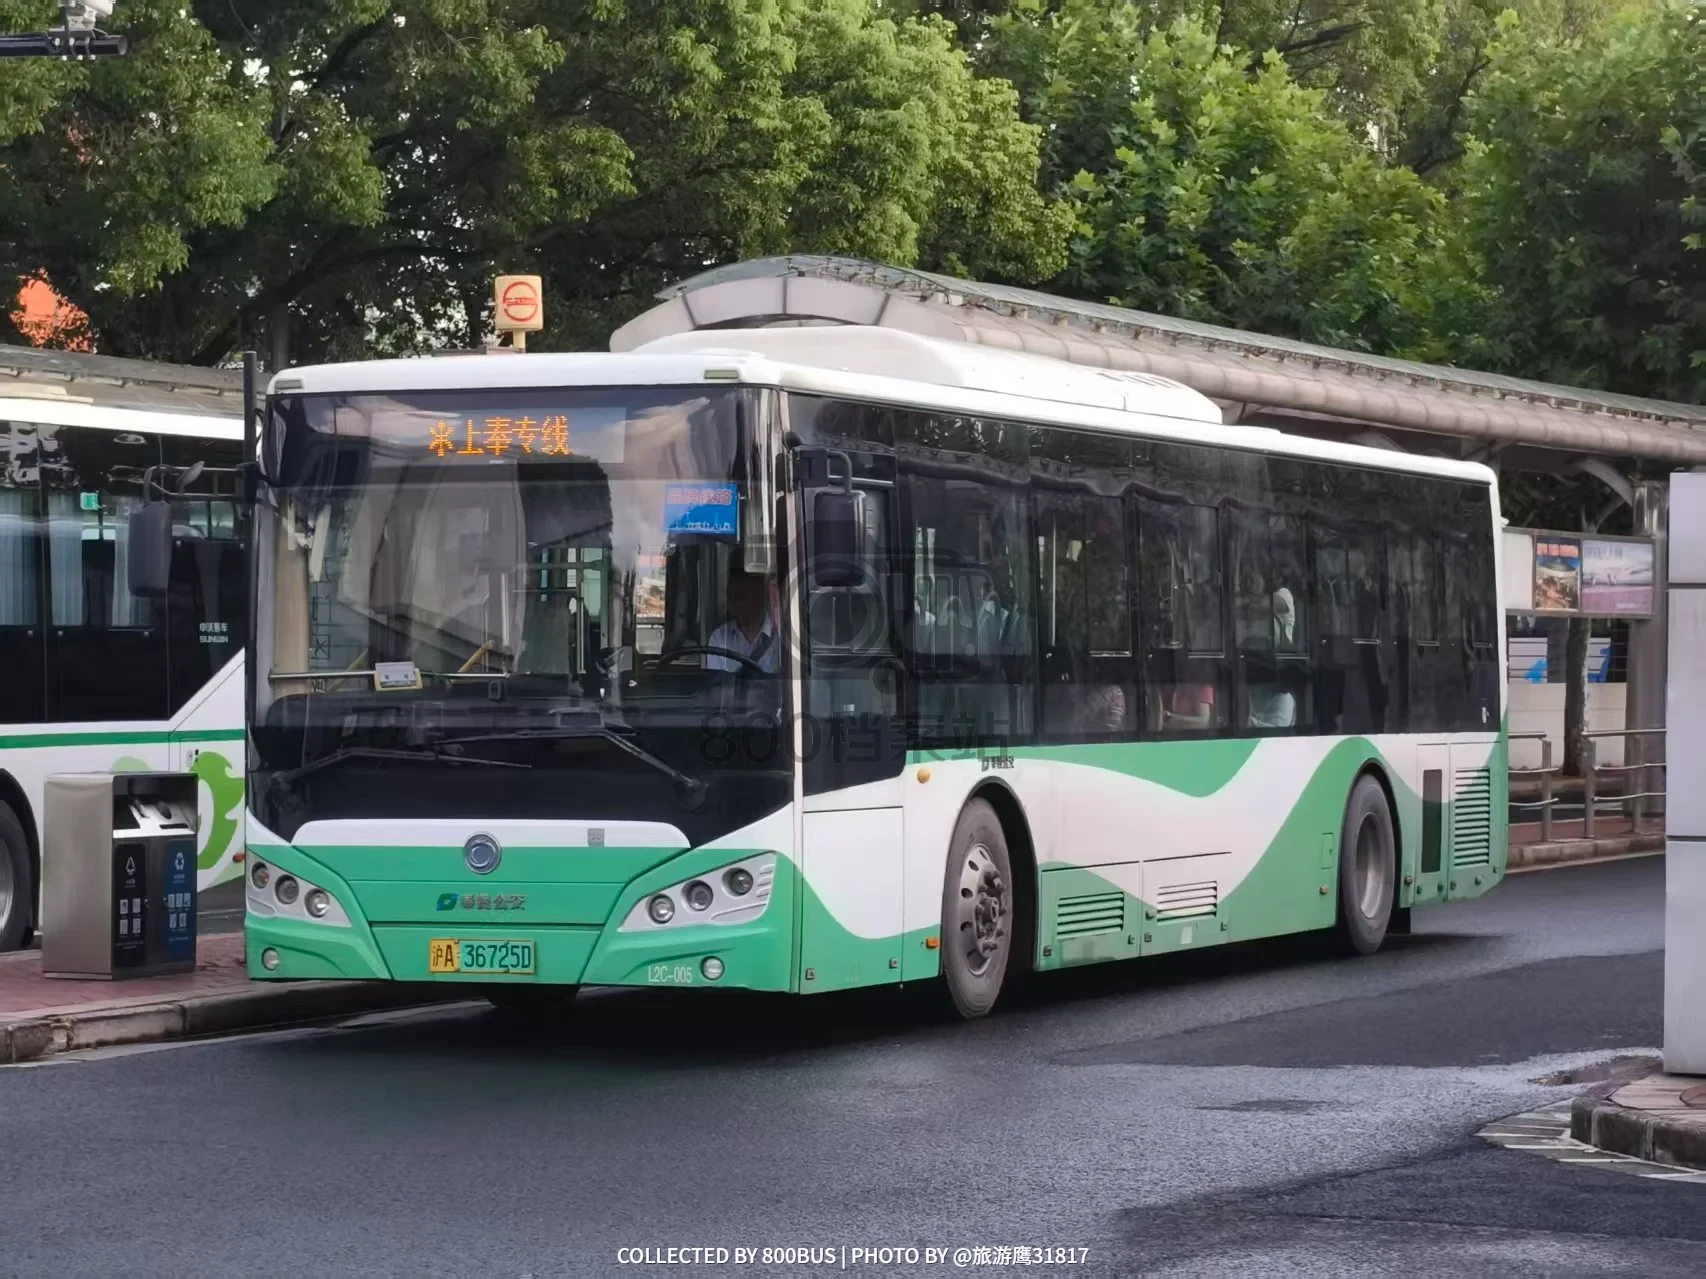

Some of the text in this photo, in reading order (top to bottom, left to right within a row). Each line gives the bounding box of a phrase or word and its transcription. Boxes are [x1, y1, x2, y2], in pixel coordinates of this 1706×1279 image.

[432, 944, 532, 969] 沪A 36725D
[648, 965, 693, 983] L2C-005
